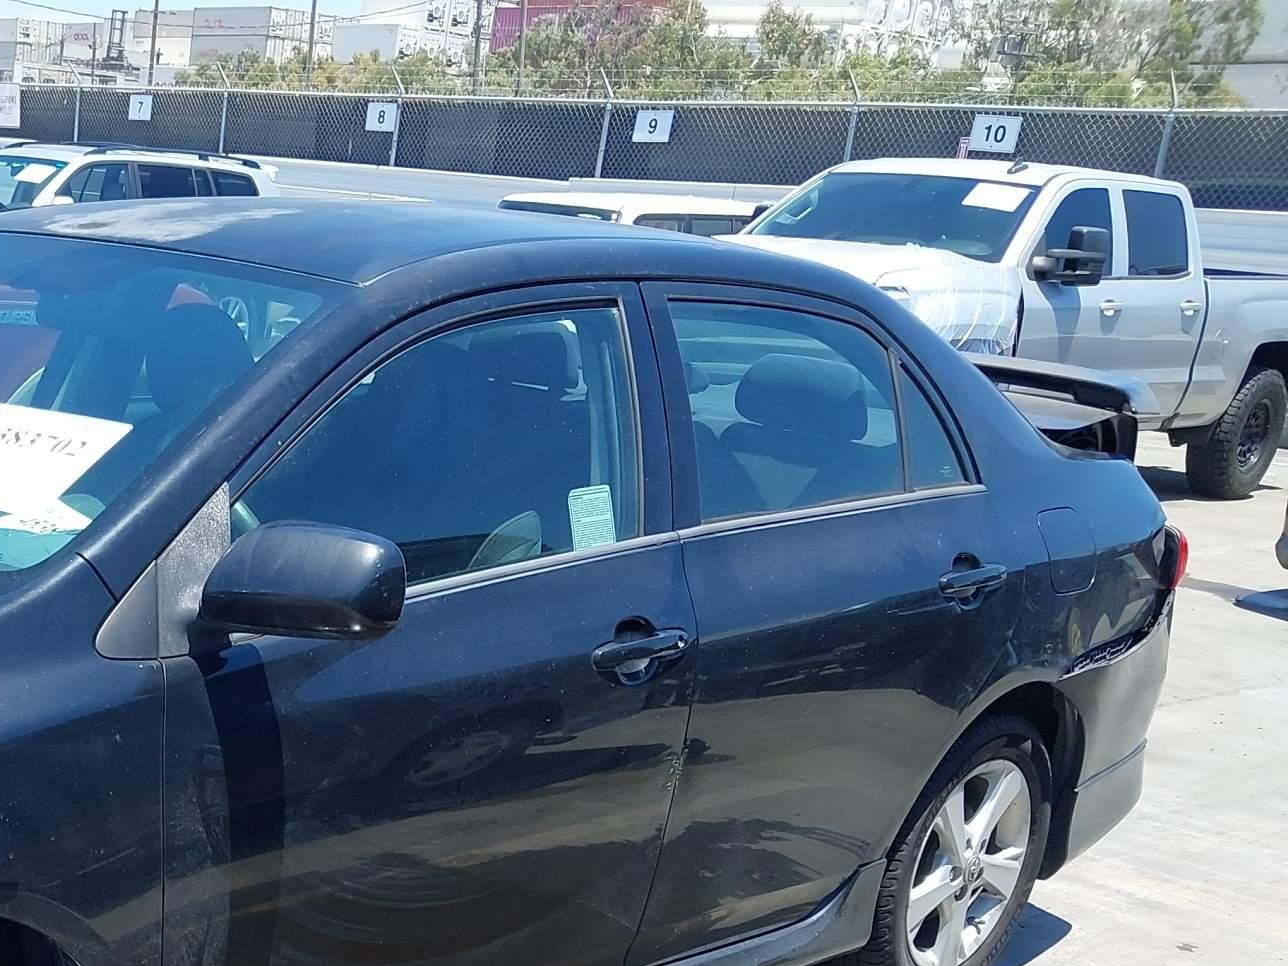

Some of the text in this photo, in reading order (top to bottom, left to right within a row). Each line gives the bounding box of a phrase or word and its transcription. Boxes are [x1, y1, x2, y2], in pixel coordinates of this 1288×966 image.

[138, 101, 143, 113] 7
[378, 110, 385, 124] 8
[648, 118, 657, 134] 9
[984, 124, 1006, 143] 10
